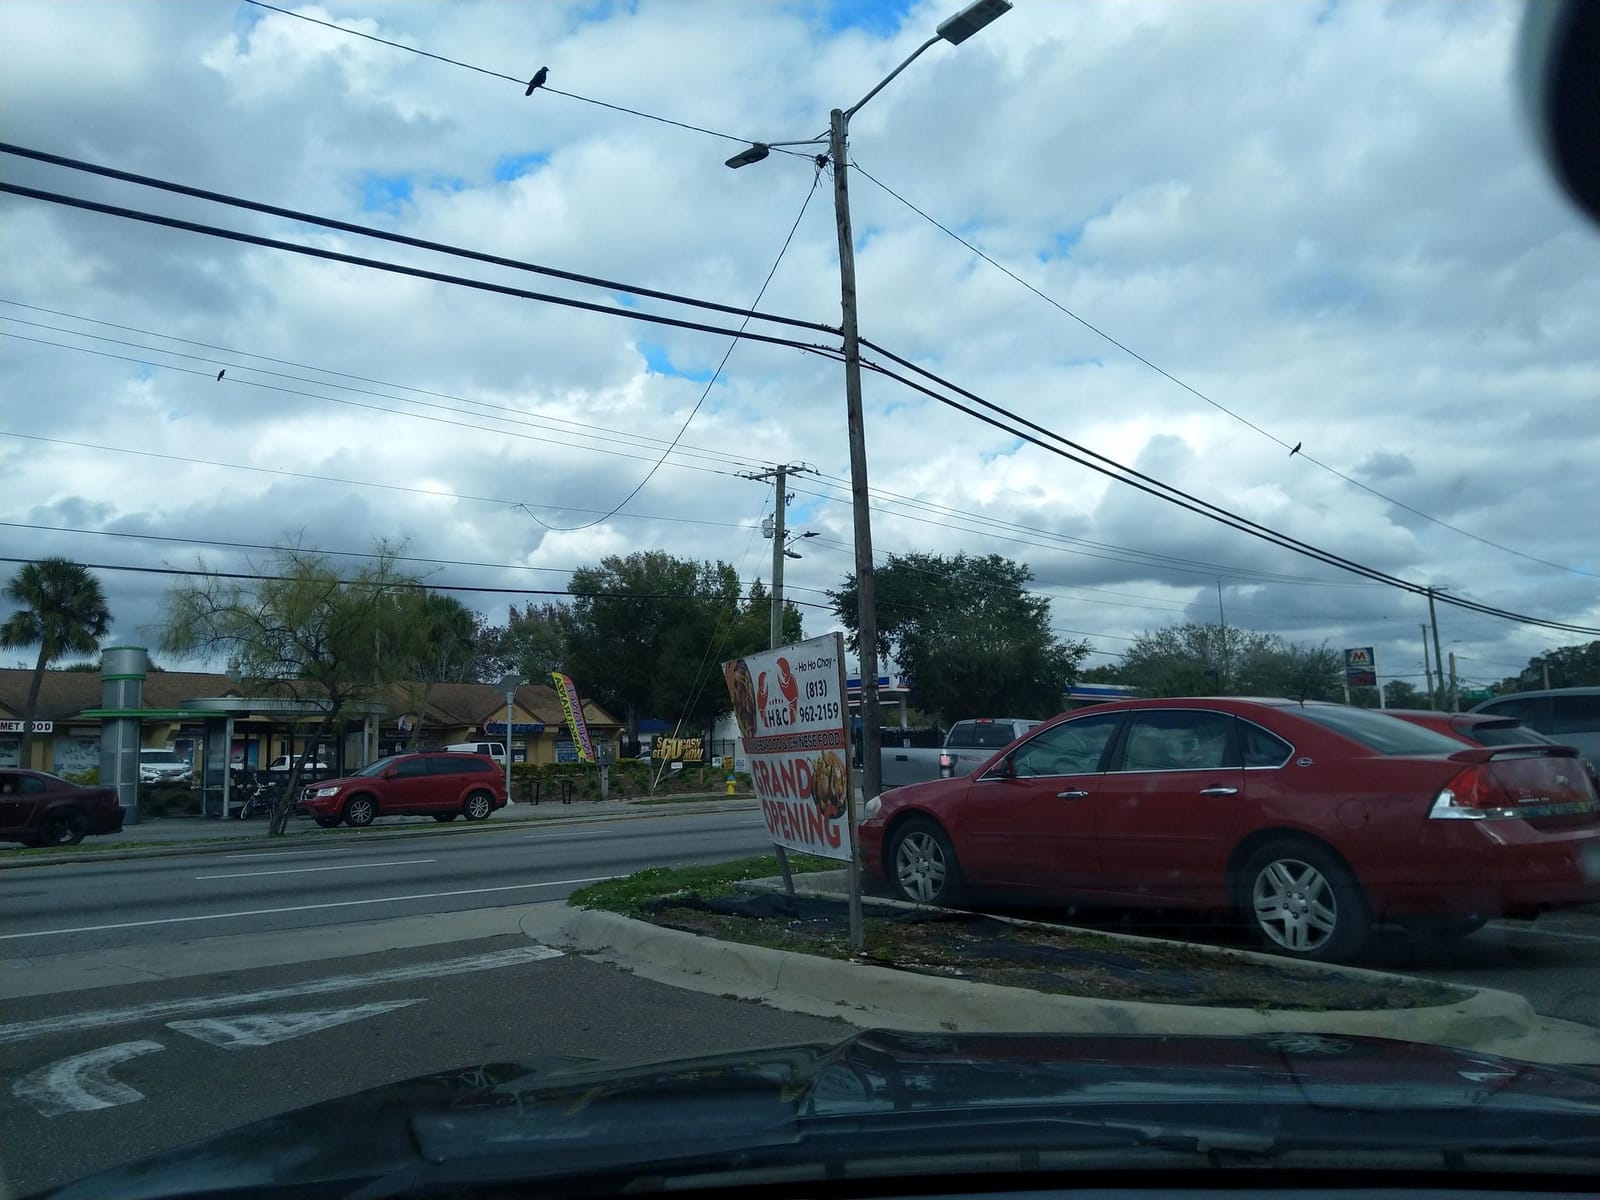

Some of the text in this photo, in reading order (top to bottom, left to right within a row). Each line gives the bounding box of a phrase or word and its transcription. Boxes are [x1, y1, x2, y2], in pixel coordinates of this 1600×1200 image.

[798, 661, 807, 673] Ho
[808, 659, 816, 671] Ho
[817, 657, 832, 669] Choy
[805, 679, 827, 700] (813)
[768, 707, 789, 728] H&C
[799, 702, 839, 723] 962-2159
[788, 734, 817, 749] CHINESE
[818, 732, 840, 746] FOOD
[683, 748, 704, 760] NOW
[752, 758, 813, 799] GRAND
[762, 799, 841, 849] OPENING
